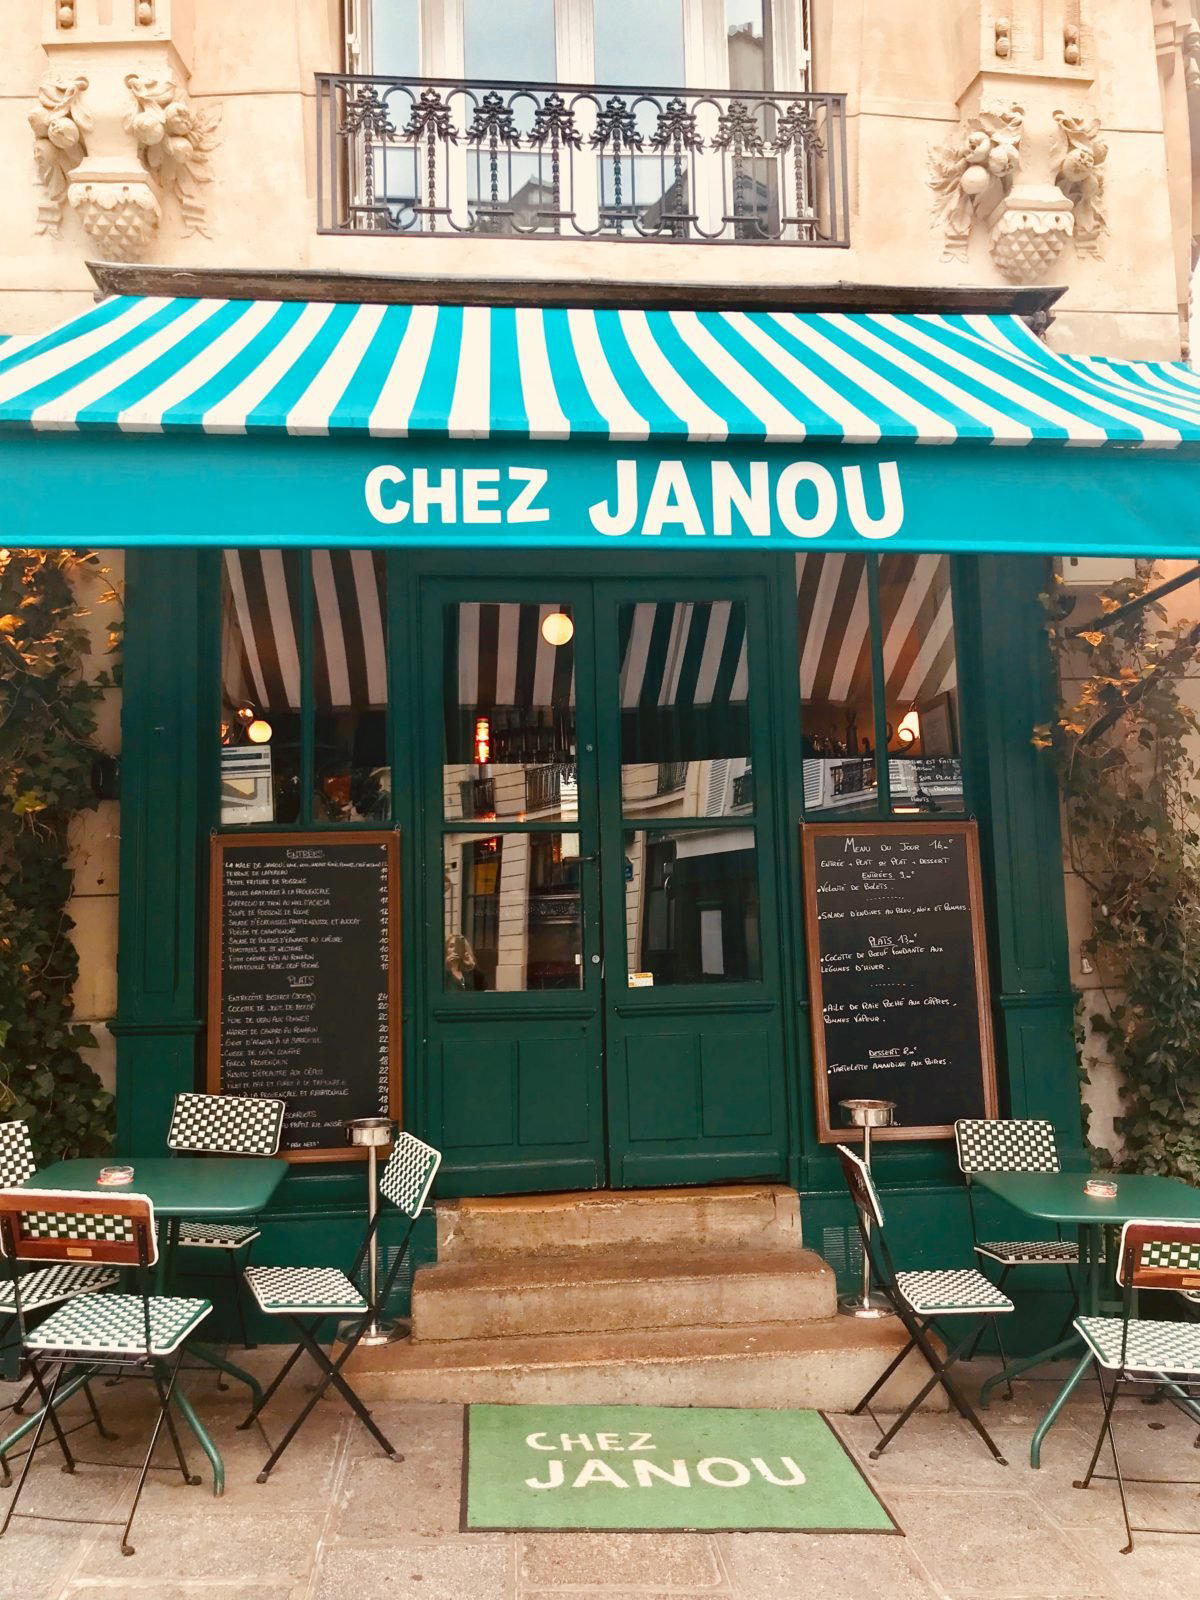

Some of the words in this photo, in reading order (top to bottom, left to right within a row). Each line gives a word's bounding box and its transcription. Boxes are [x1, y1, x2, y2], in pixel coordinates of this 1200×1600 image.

[364, 464, 550, 526] CHEZ
[588, 459, 904, 540] JANOU
[844, 837, 871, 853] MENU
[880, 844, 892, 852] DU
[899, 842, 921, 852] JOUR
[855, 858, 874, 866] PLAT
[890, 857, 908, 866] PLAT
[919, 857, 950, 865] DESSERT
[861, 870, 895, 880] ENTRÉES
[821, 911, 845, 920] SALADE
[934, 904, 943, 912] ET
[868, 935, 898, 948] PLATS
[824, 953, 853, 963] COCOTTE
[287, 974, 315, 987] PLATS
[853, 1014, 880, 1024] VAPEUR
[868, 1048, 901, 1059] DESSERT
[525, 1431, 657, 1451] CHEZ
[524, 1456, 807, 1489] JANOU
